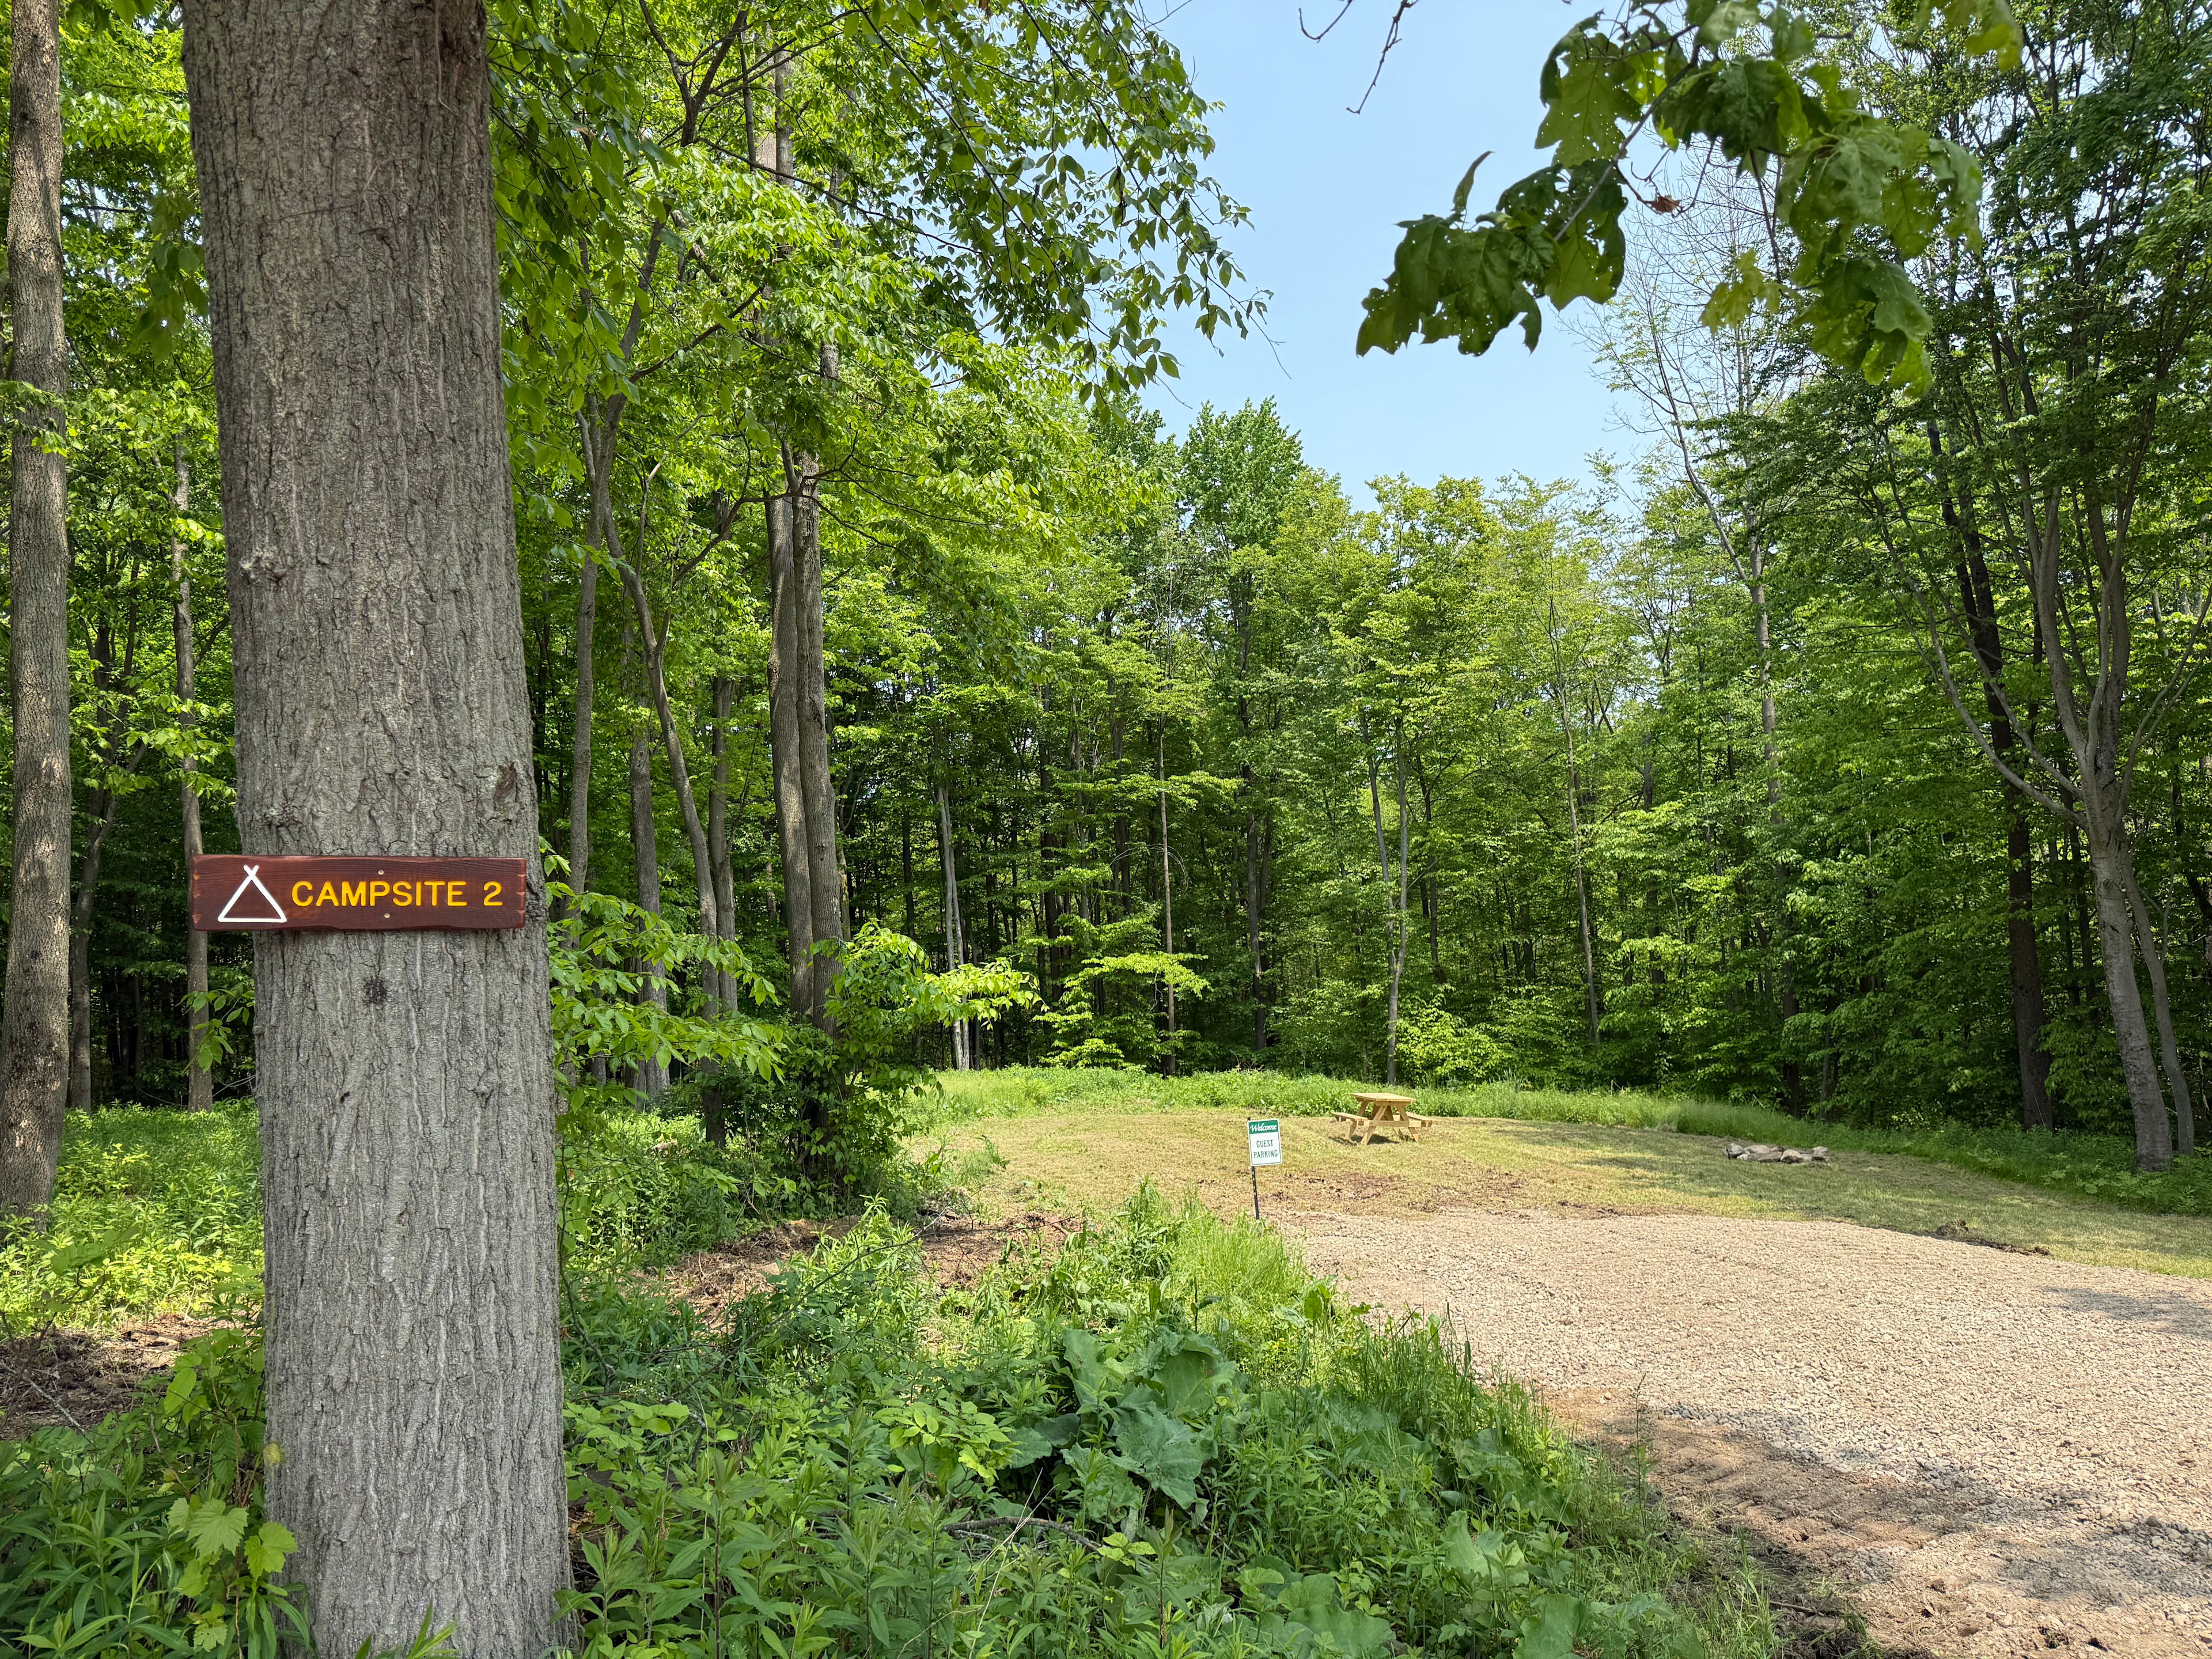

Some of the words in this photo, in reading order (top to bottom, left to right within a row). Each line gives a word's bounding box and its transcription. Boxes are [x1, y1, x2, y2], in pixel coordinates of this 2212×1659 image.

[291, 881, 467, 907] CAMPSITE
[483, 881, 503, 907] 2
[1250, 1123, 1277, 1132] Welcome
[1256, 1139, 1273, 1148] GUEST
[1253, 1150, 1278, 1158] PARKING
